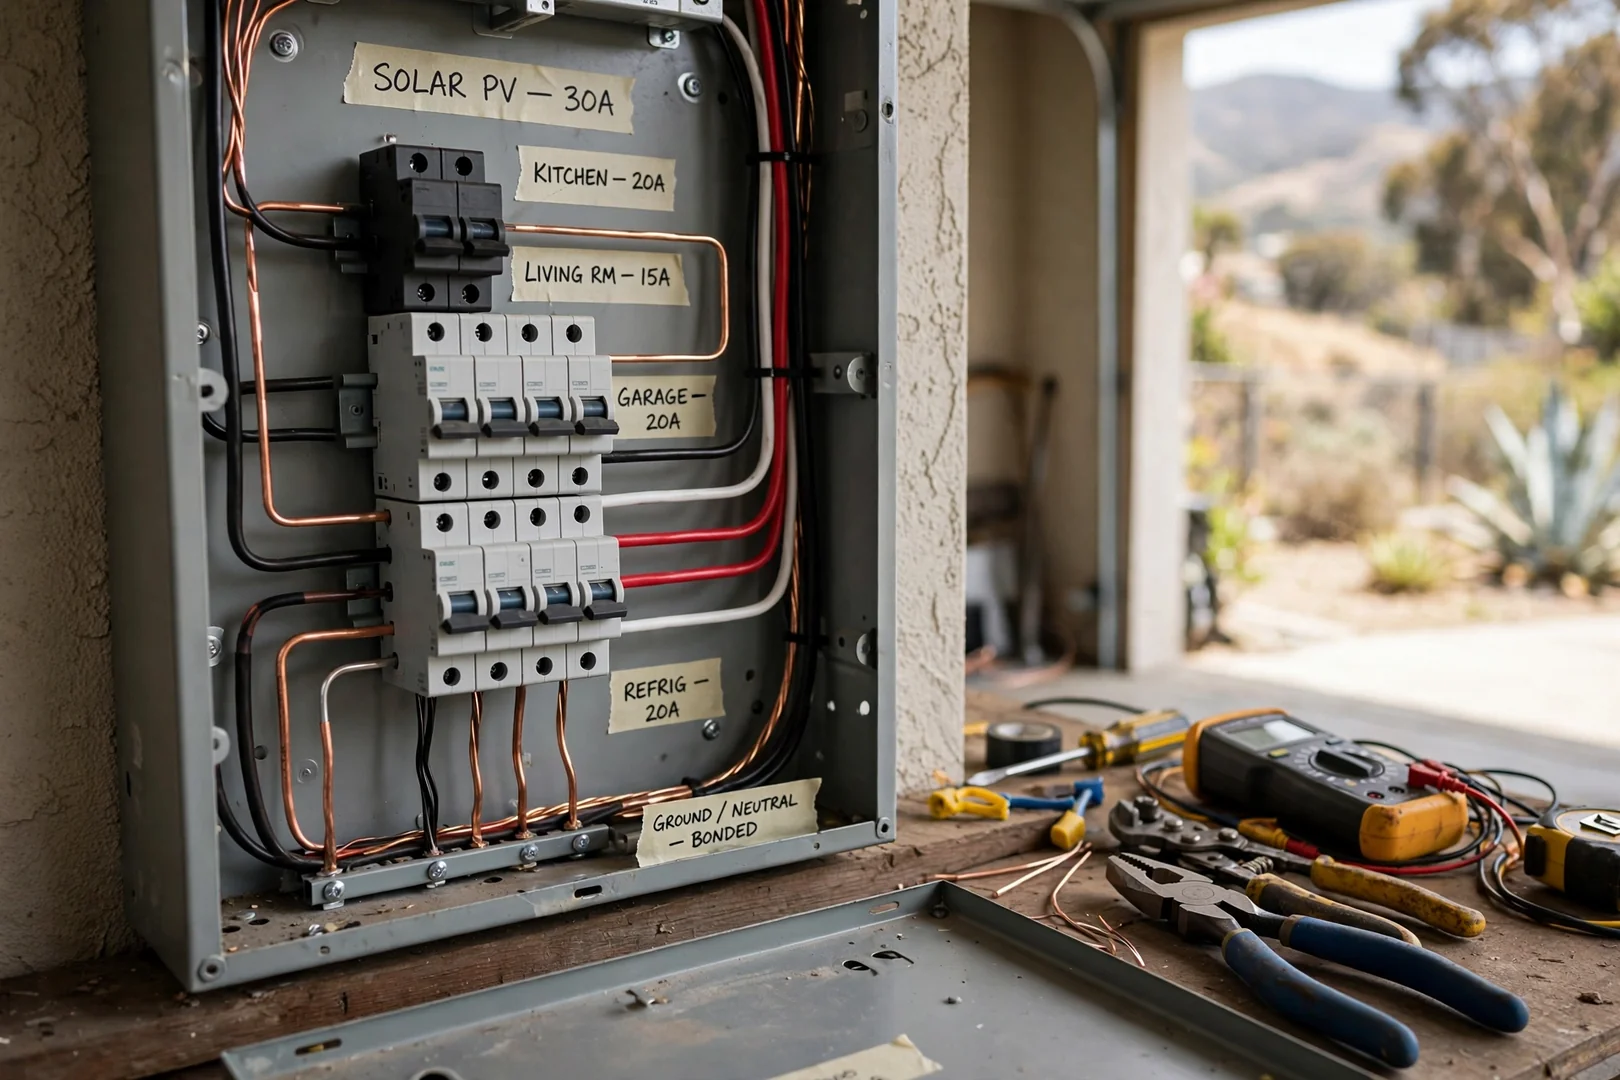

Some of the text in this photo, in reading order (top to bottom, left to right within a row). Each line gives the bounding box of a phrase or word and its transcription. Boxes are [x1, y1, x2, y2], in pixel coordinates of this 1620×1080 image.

[373, 62, 466, 98] SOLAR
[483, 74, 517, 103] PV
[564, 86, 614, 116] 30A
[534, 161, 608, 186] KITCHEN
[632, 171, 665, 192] 20A
[525, 261, 583, 284] LIVING
[591, 265, 616, 284] RM
[641, 267, 670, 287] 15A
[646, 412, 680, 431] 20A
[624, 675, 687, 702] REFRIG
[645, 700, 680, 722] 20A
[653, 808, 712, 832] GROUND
[732, 793, 798, 818] NEUTRAL
[691, 821, 758, 848] BONDED
